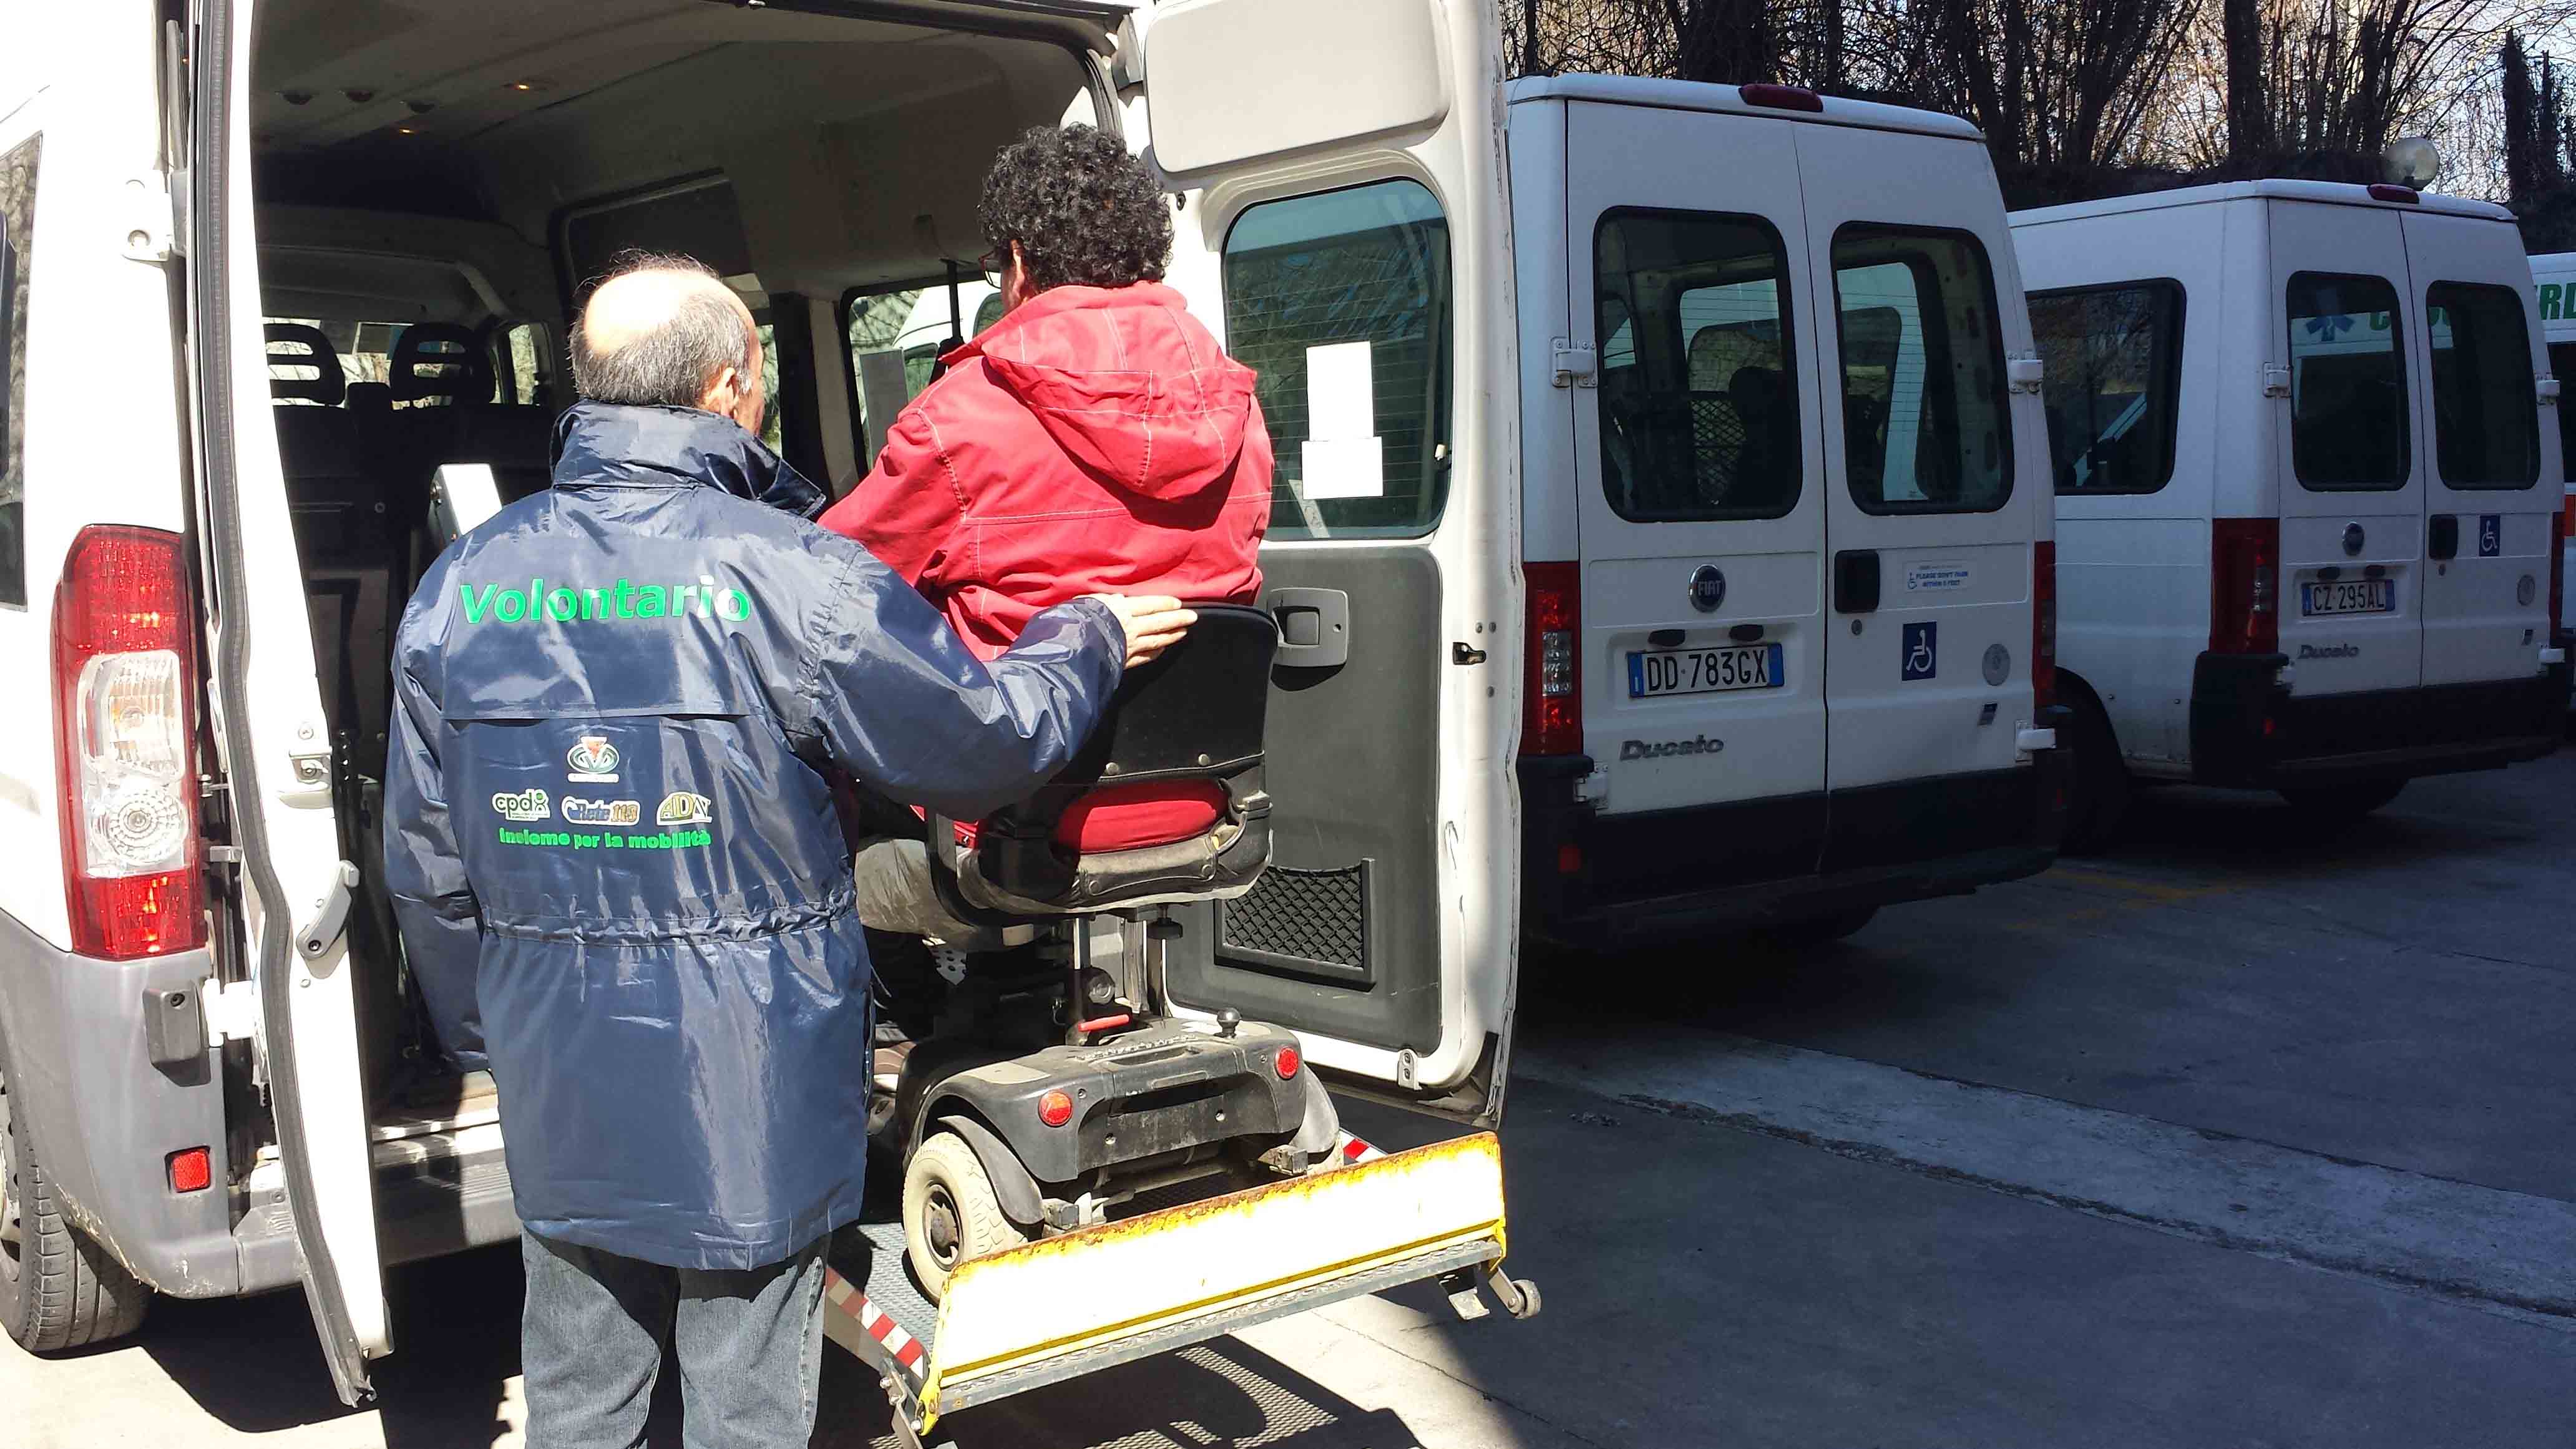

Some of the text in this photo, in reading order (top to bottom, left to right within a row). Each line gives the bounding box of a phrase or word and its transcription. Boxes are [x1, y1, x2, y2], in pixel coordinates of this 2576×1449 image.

[460, 575, 751, 623] Volontario
[1697, 580, 1722, 595] FIAT
[2313, 583, 2385, 610] CZ 295AL
[1646, 656, 1679, 691] DD
[1688, 650, 1767, 688] 783GX
[1619, 734, 1725, 761] Ducato
[499, 827, 571, 846] Insieme
[573, 833, 600, 849] per
[605, 832, 623, 847] la
